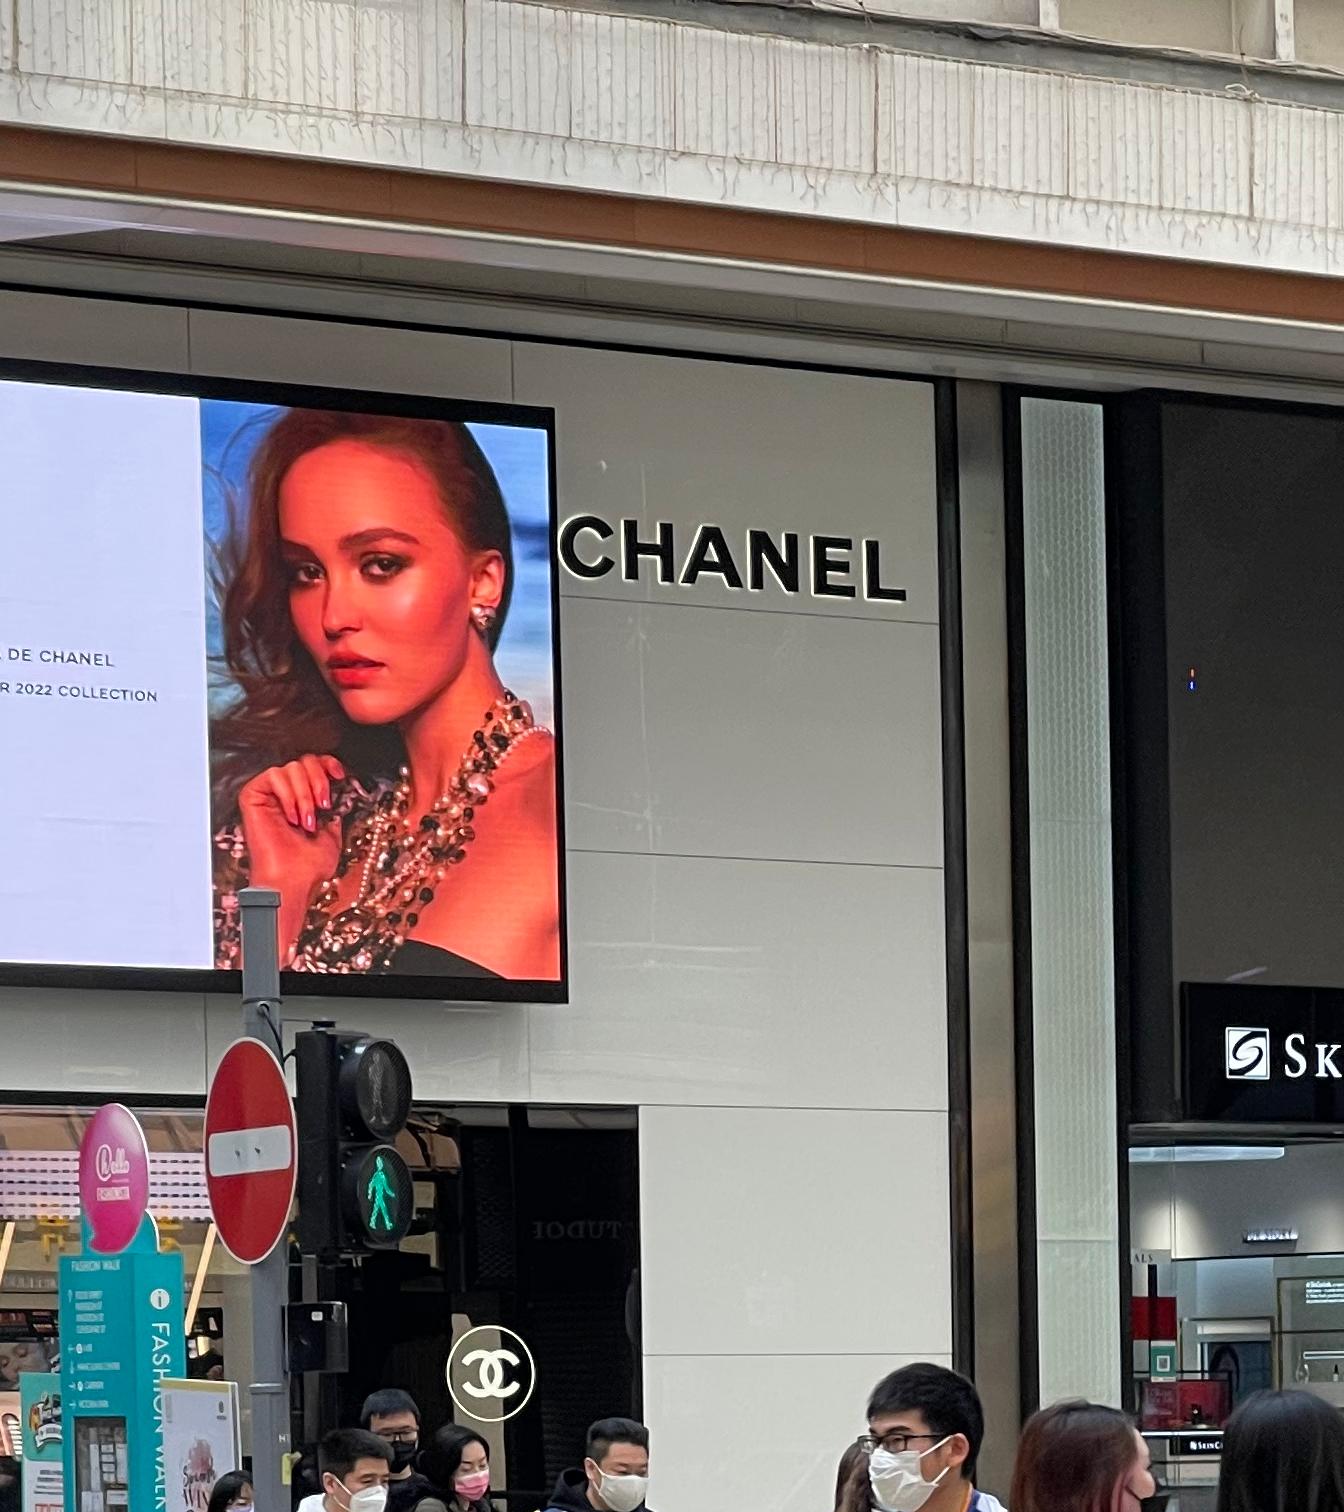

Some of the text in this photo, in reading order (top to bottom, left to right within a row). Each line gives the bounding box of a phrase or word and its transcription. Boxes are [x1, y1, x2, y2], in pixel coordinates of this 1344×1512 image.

[558, 514, 907, 601] CHANEL
[8, 648, 115, 667] DE CHANEL
[16, 683, 52, 696] 2022
[58, 685, 157, 702] COLLECTION
